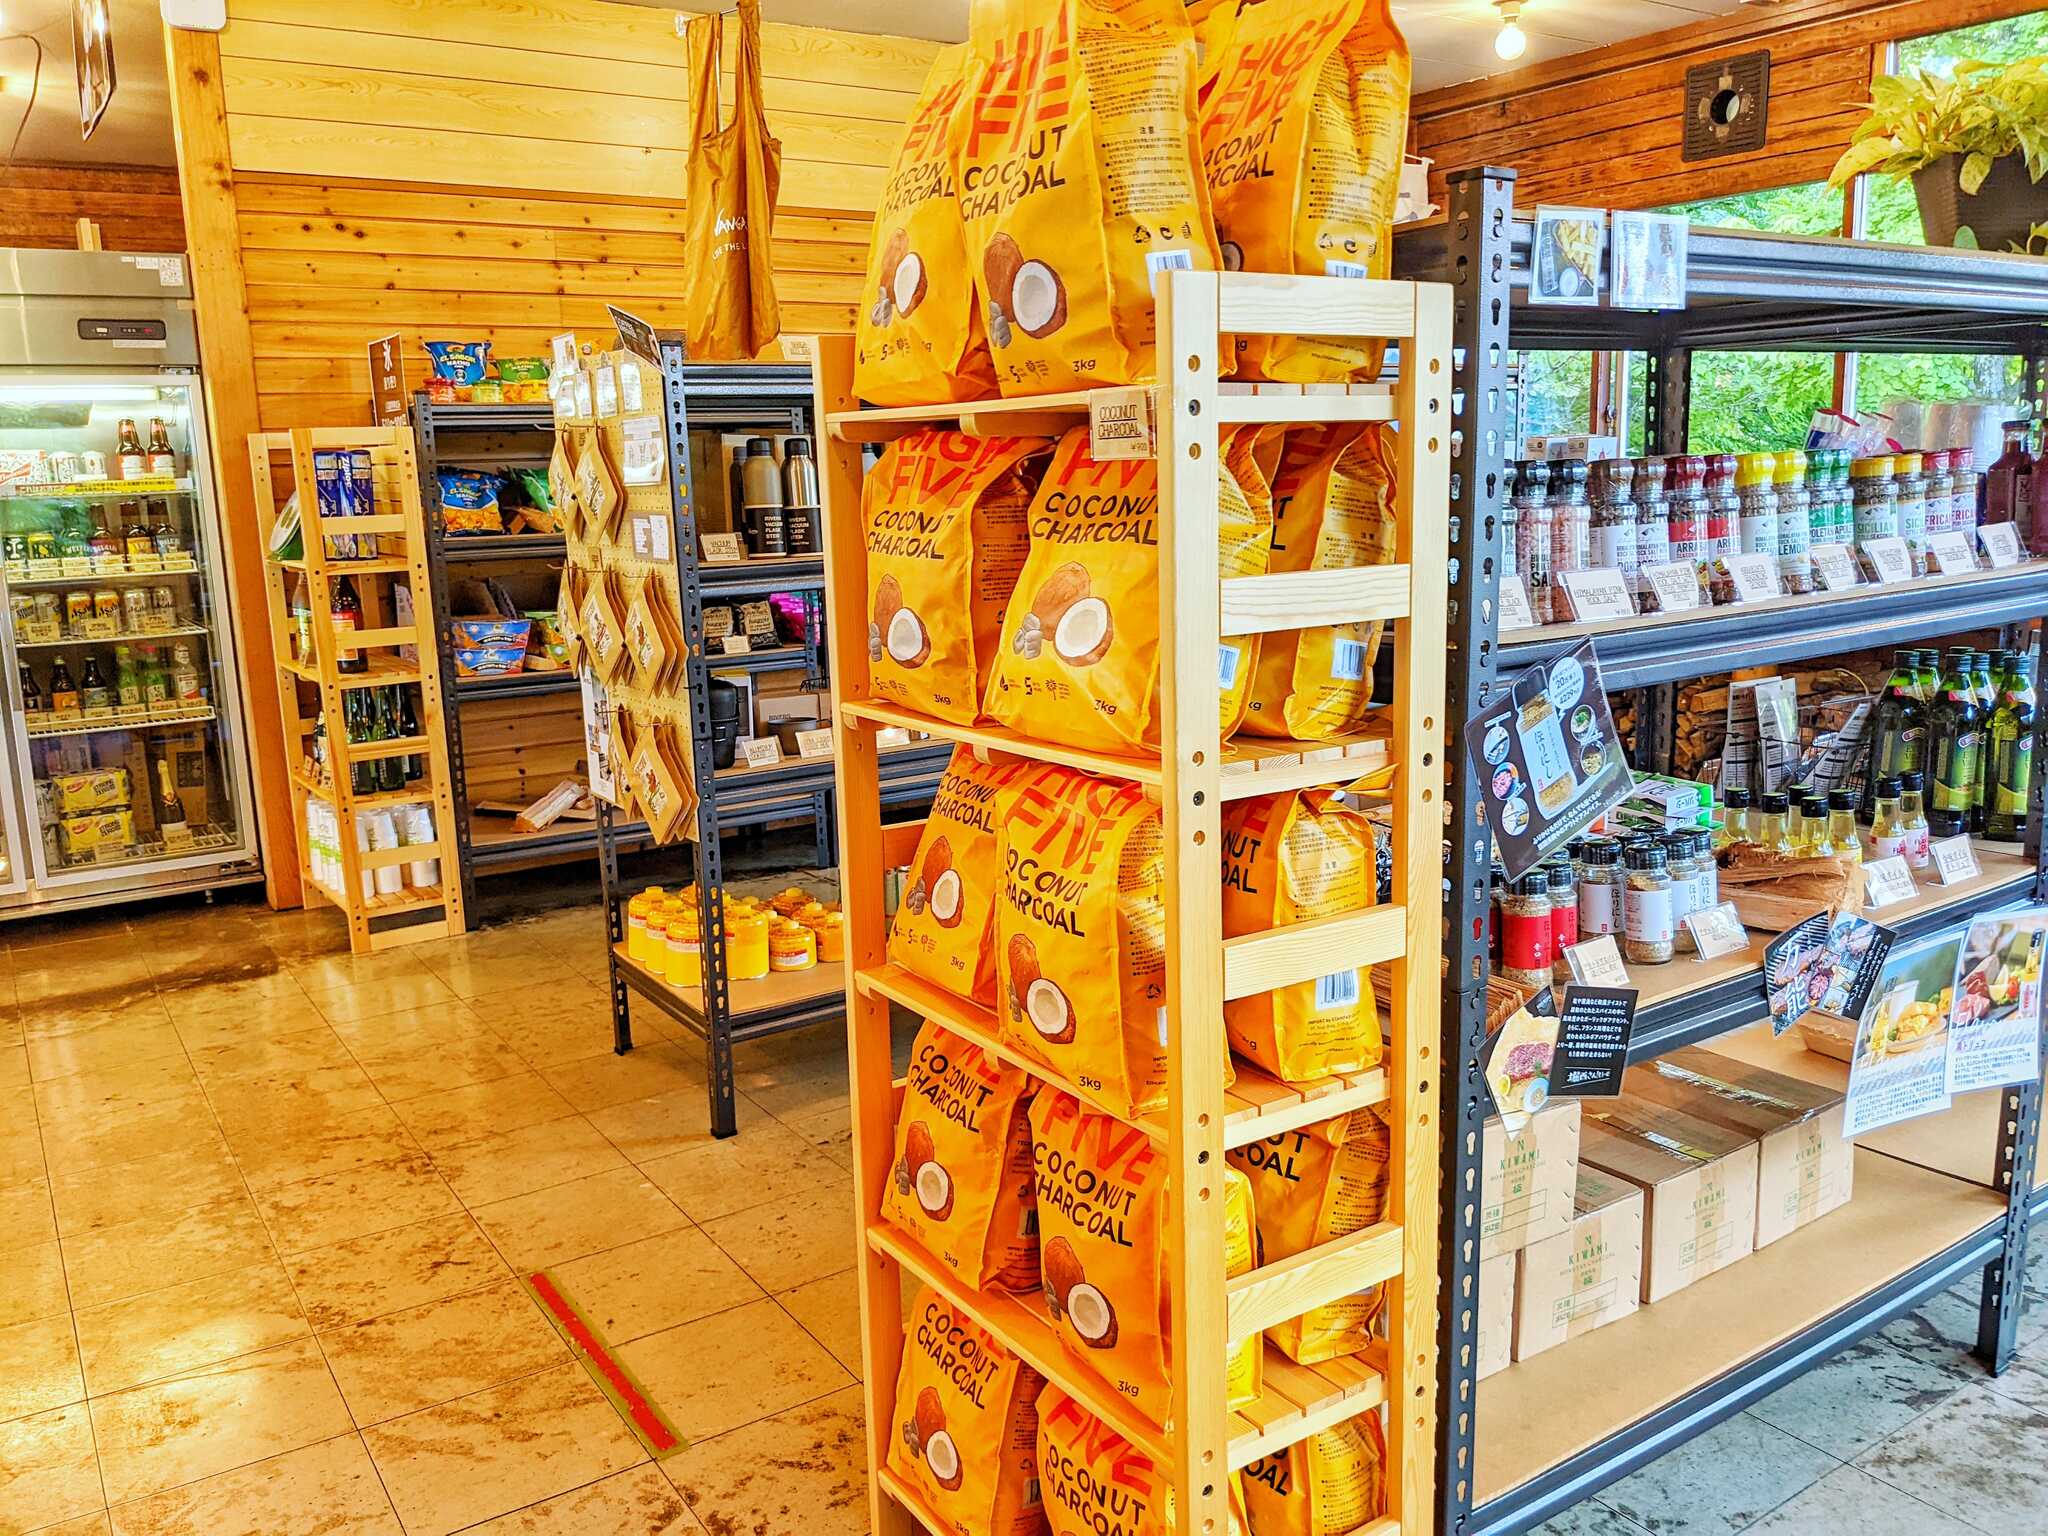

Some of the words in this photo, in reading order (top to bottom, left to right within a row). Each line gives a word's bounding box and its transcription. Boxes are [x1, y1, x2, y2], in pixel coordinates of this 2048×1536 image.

[1072, 357, 1096, 375] 3kg
[1099, 404, 1138, 421] COCONUT
[1097, 422, 1142, 438] CHARCOAL
[1032, 518, 1158, 546] CHARCOAL
[867, 532, 945, 560] CHARCOAL
[1094, 700, 1117, 716] 3kg
[1004, 788, 1118, 874] FIVE
[950, 956, 965, 971] 3kg
[919, 1044, 993, 1104] COCONUT
[1079, 1074, 1101, 1091] 3kg
[910, 1066, 981, 1134] CHARCOAL
[1500, 1149, 1540, 1170] KIWAMI
[1034, 1142, 1137, 1217] COCONUT
[944, 1250, 959, 1268] 3kg
[1568, 1242, 1609, 1265] KIWAMI
[925, 1302, 999, 1383] COCONUT
[917, 1325, 985, 1410] CHARCOAL
[1117, 1380, 1139, 1397] 3kg
